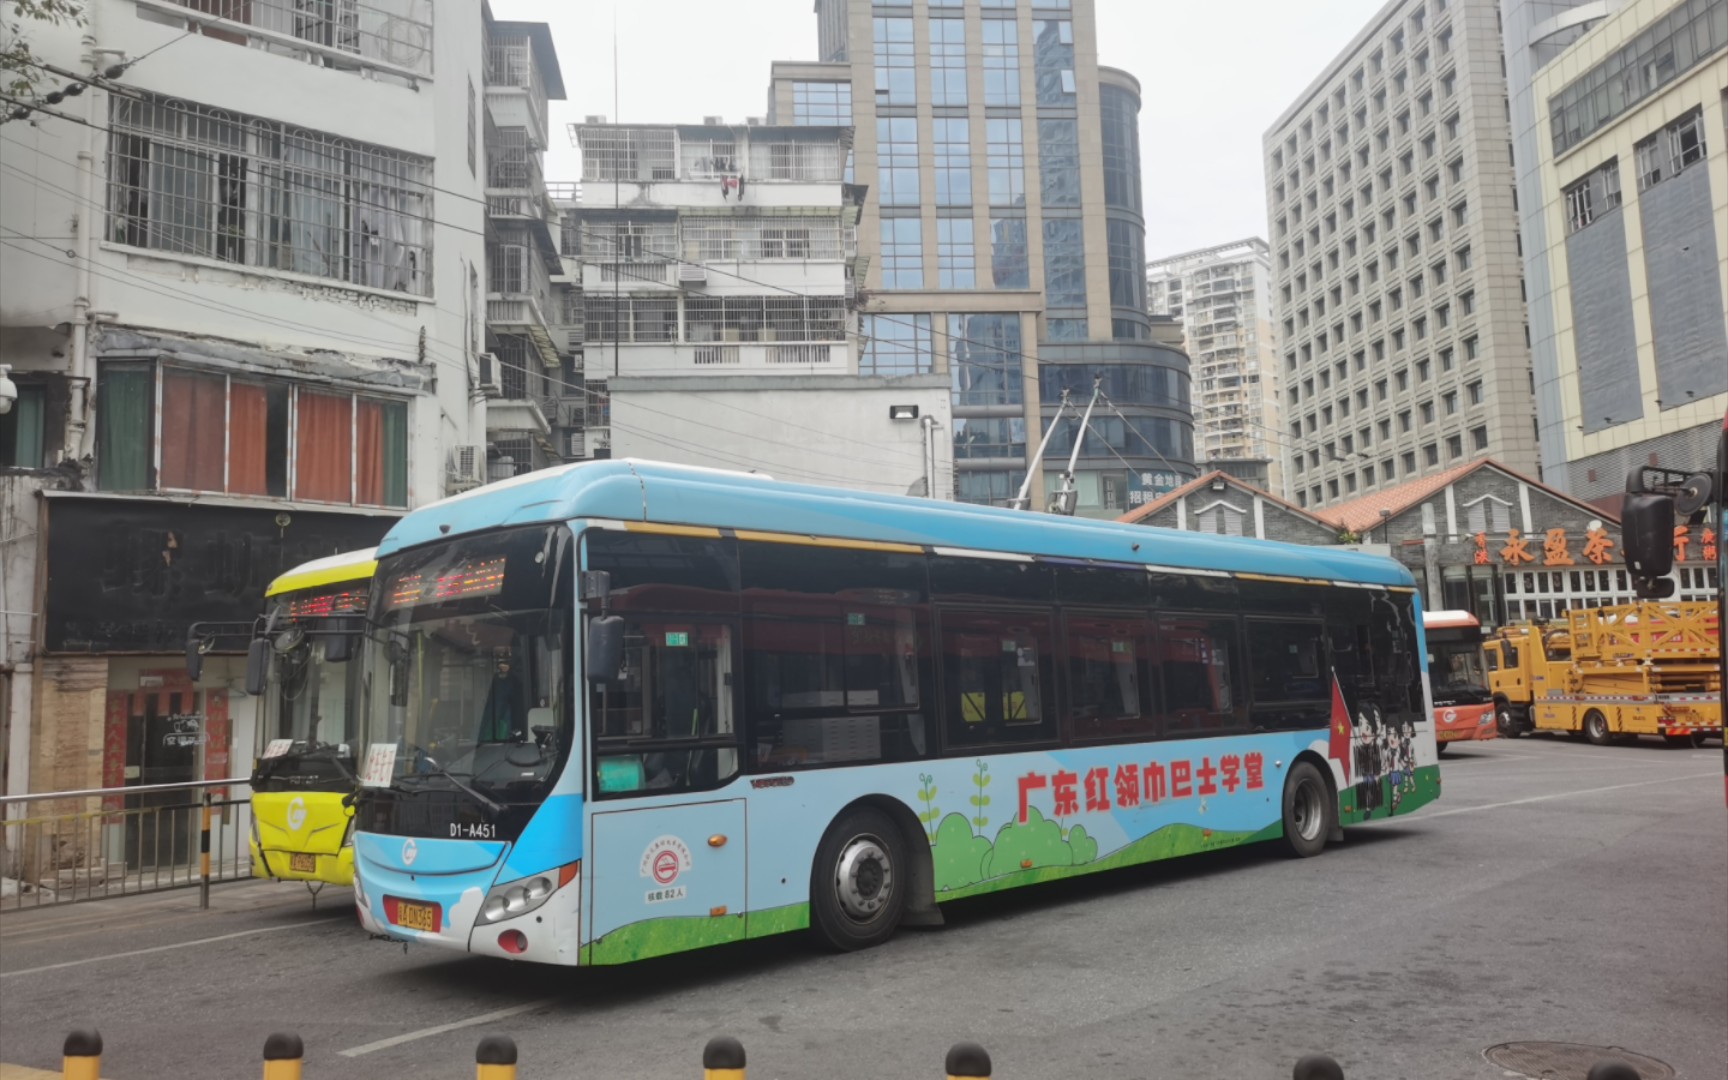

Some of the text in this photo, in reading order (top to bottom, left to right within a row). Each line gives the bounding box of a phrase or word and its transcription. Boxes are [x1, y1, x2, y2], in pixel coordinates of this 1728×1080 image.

[1017, 752, 1264, 824] 广东红领巾巴士学堂
[450, 822, 496, 838] D1-A451
